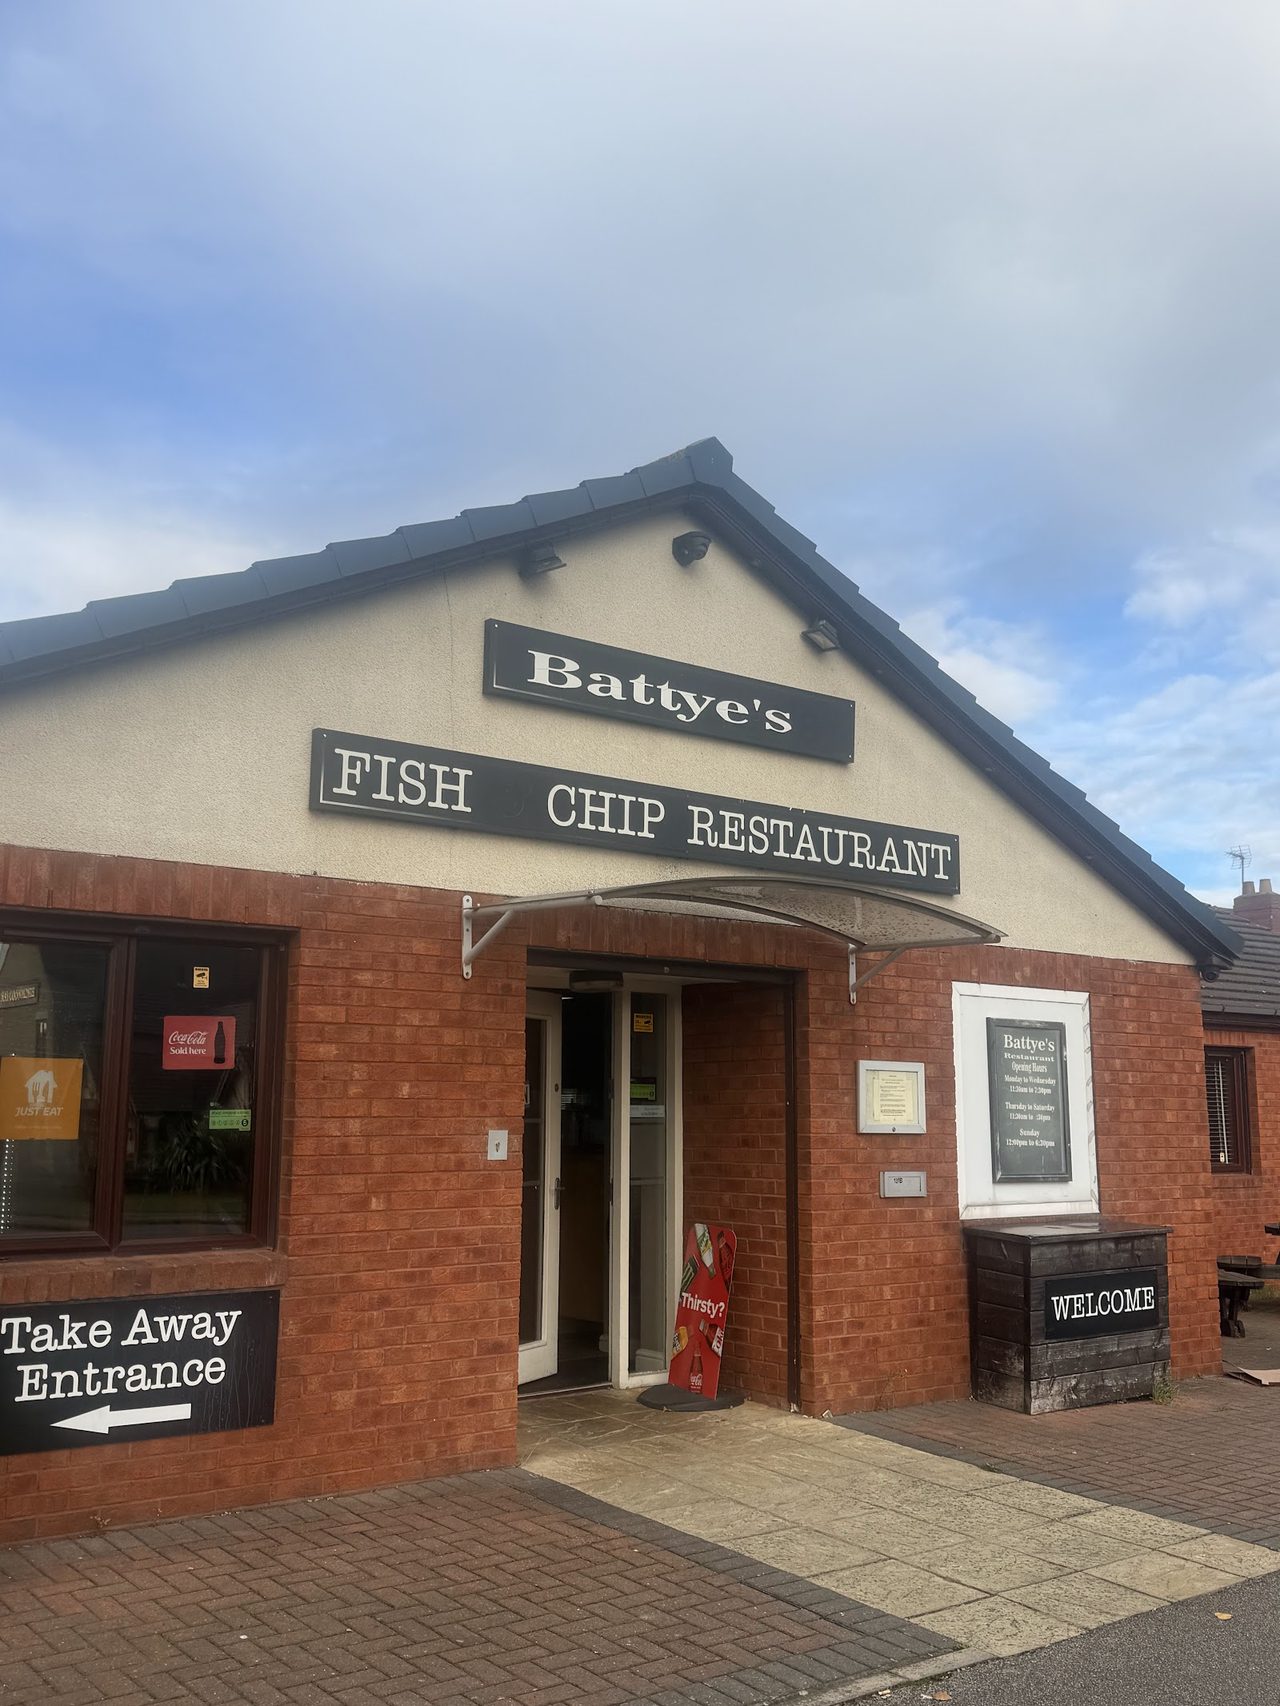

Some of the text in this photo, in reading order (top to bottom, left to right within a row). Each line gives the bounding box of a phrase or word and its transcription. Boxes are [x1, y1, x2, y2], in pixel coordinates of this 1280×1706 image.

[527, 650, 792, 733] Battye's
[333, 748, 952, 881] FISH CHIP RESTAURANT
[1003, 1034, 1055, 1053] Battye's
[170, 1047, 207, 1055] Sold here
[1003, 1052, 1055, 1062] Restaurant
[1011, 1061, 1048, 1073] Opening Hours
[1004, 1074, 1023, 1085] Monday
[1029, 1076, 1057, 1087] Wednesday
[15, 1106, 64, 1117] JUST EAT
[1005, 1101, 1027, 1112] Thursday
[1033, 1103, 1055, 1113] Saturday
[1019, 1128, 1041, 1138] Sunday
[1028, 1139, 1035, 1147] to
[681, 1292, 725, 1318] Thirsty?
[1051, 1286, 1155, 1320] WELCOME
[1, 1308, 242, 1354] Take Away
[15, 1356, 226, 1402] Entrance
